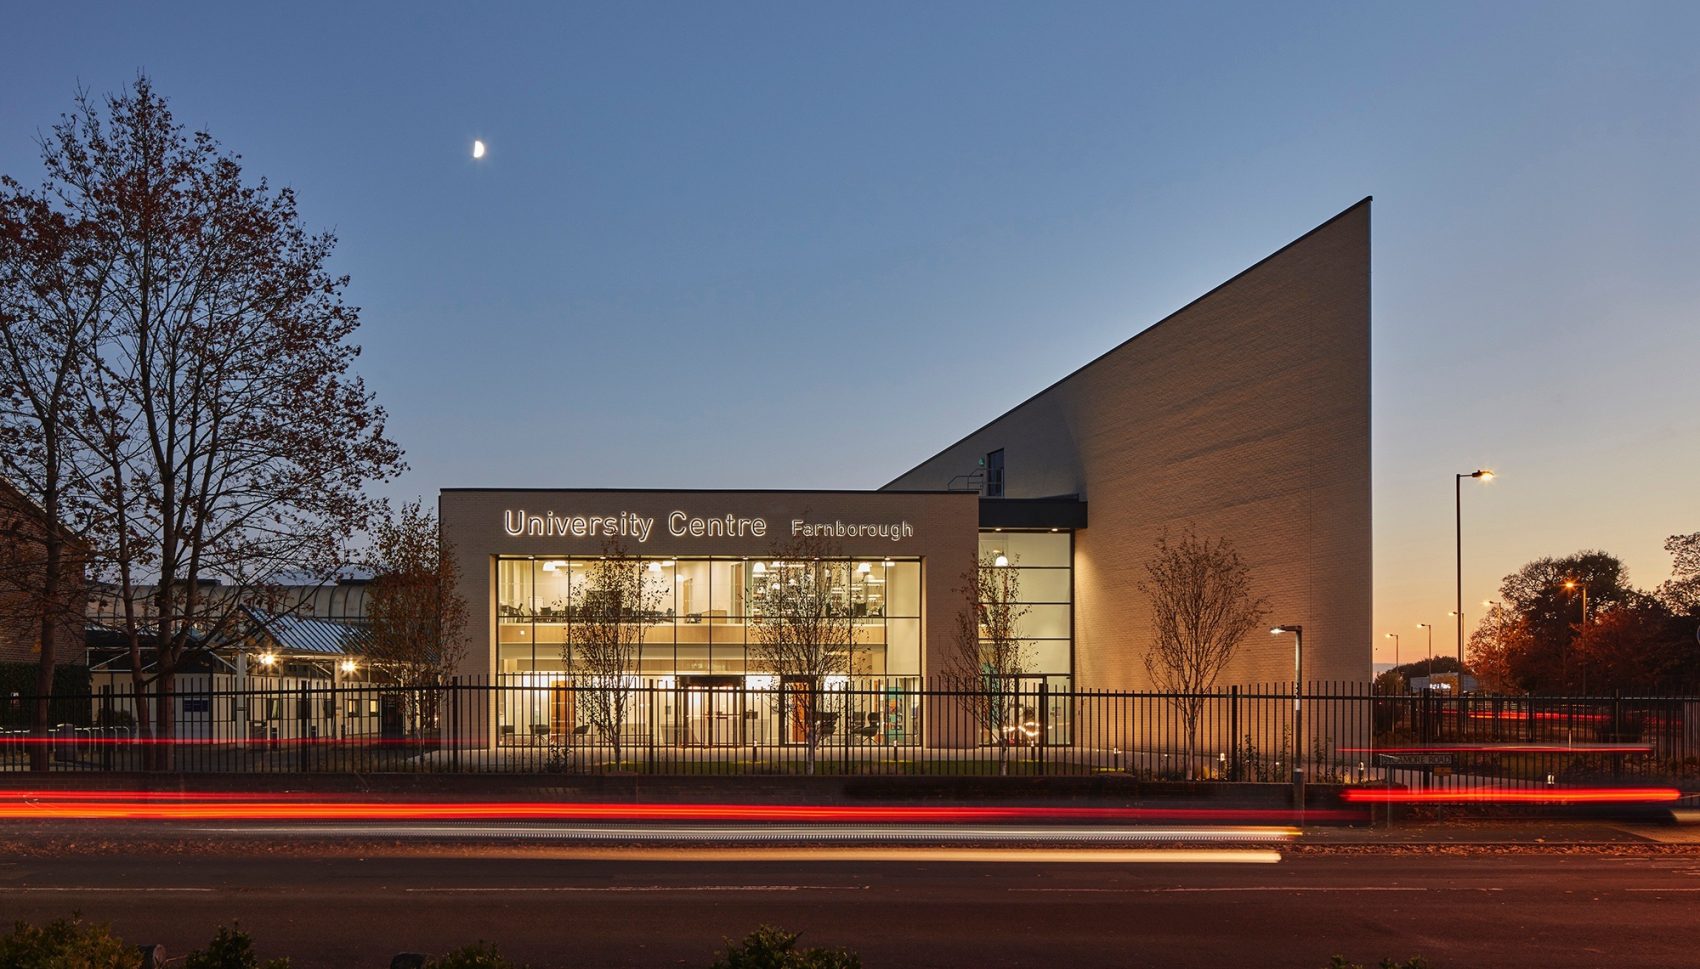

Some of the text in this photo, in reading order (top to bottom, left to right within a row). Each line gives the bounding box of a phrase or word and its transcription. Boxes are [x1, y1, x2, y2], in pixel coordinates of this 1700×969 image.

[505, 510, 913, 542] University Centre Farnborough
[1428, 755, 1452, 765] ROAD
